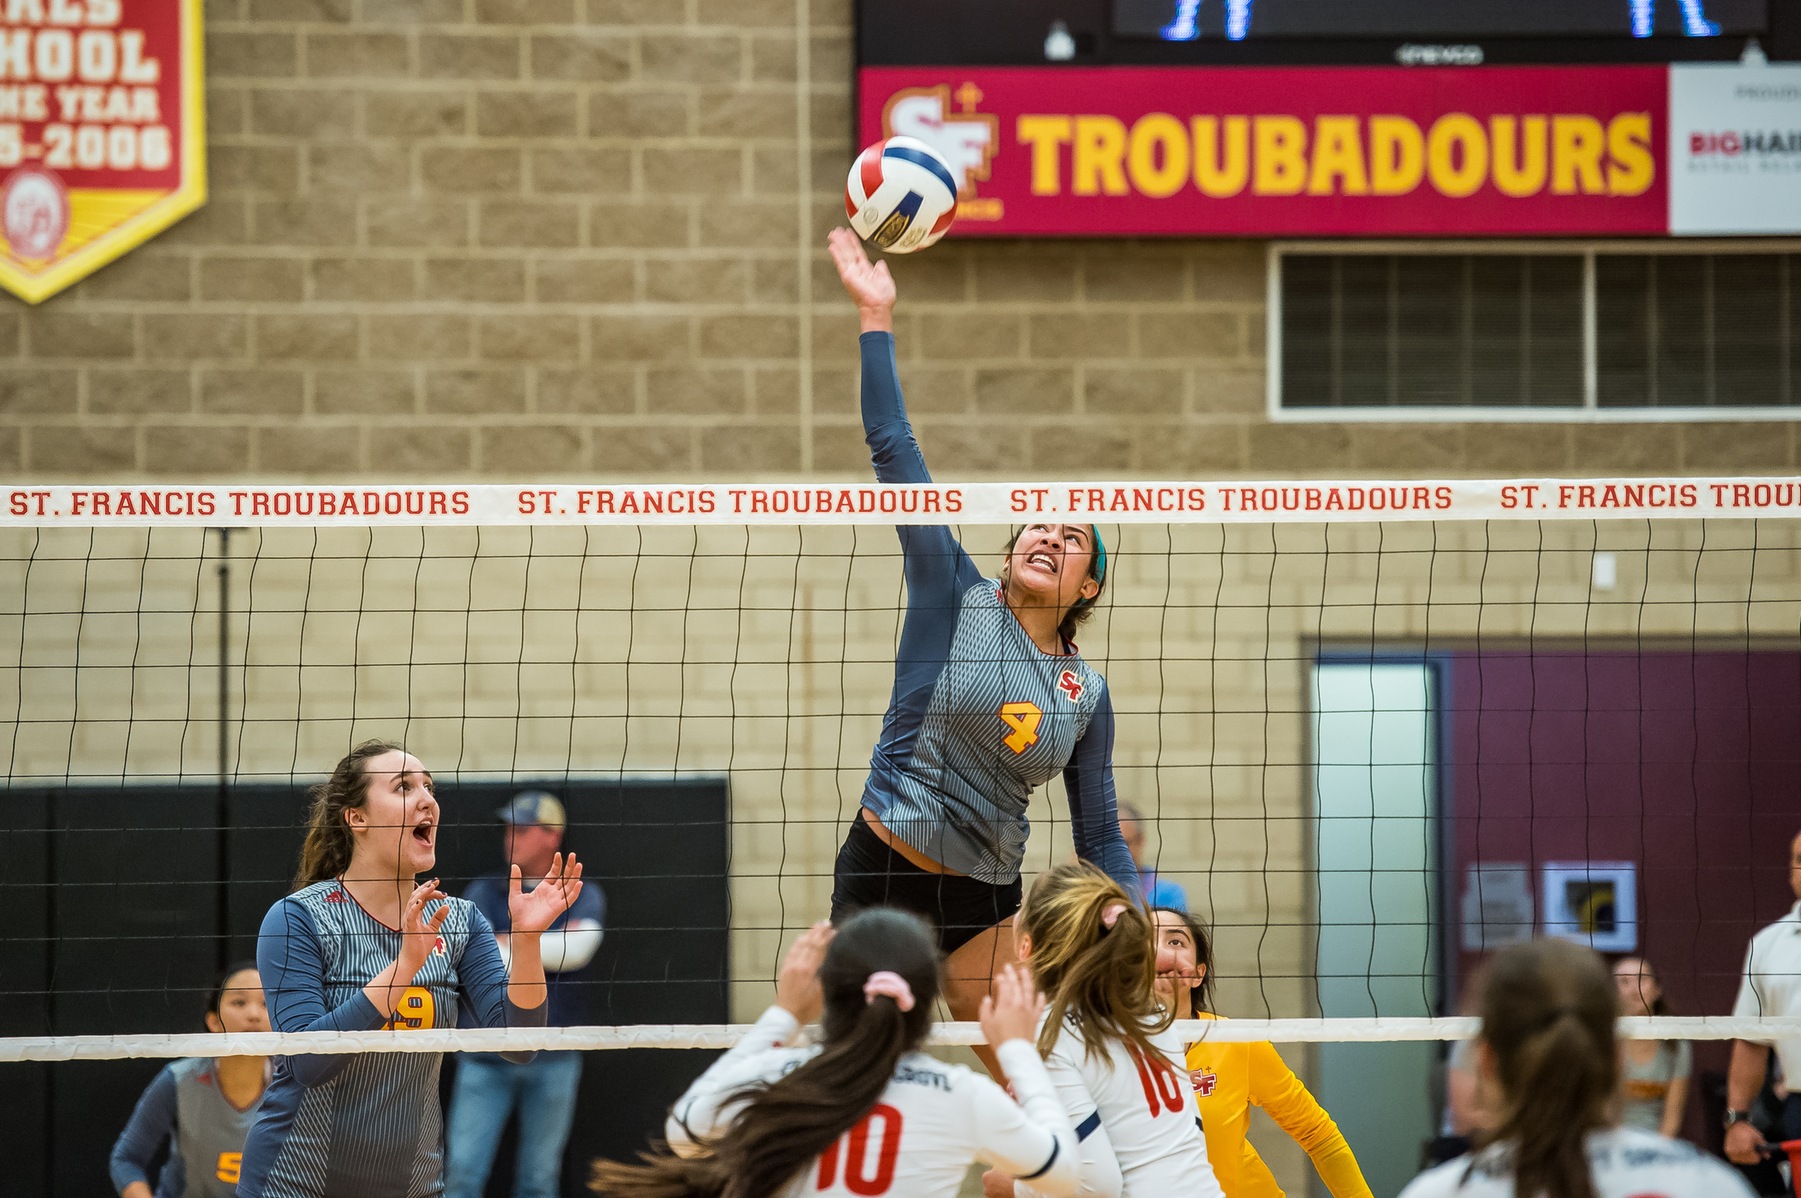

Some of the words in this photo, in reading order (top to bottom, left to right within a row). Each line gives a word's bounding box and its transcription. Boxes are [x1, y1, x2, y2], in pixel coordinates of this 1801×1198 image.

[1017, 112, 1656, 198] TROUBADOURS
[10, 491, 59, 516] ST.
[71, 491, 215, 516] FRANCIS
[229, 491, 469, 516] TROUBADOURS
[518, 491, 565, 515] ST.
[577, 490, 715, 514] FRANCIS
[728, 489, 963, 513] TROUBADOURS
[1010, 489, 1057, 513] ST.
[1068, 488, 1205, 512] FRANCIS
[1218, 486, 1452, 511] TROUBADOURS
[1501, 485, 1547, 509] ST.
[1559, 484, 1697, 509] FRANCIS
[1710, 483, 1801, 507] TROU
[998, 701, 1043, 755] 4
[380, 986, 435, 1031] 9
[1189, 1068, 1217, 1097] SF
[815, 1103, 904, 1197] 10
[216, 1152, 243, 1184] 5
